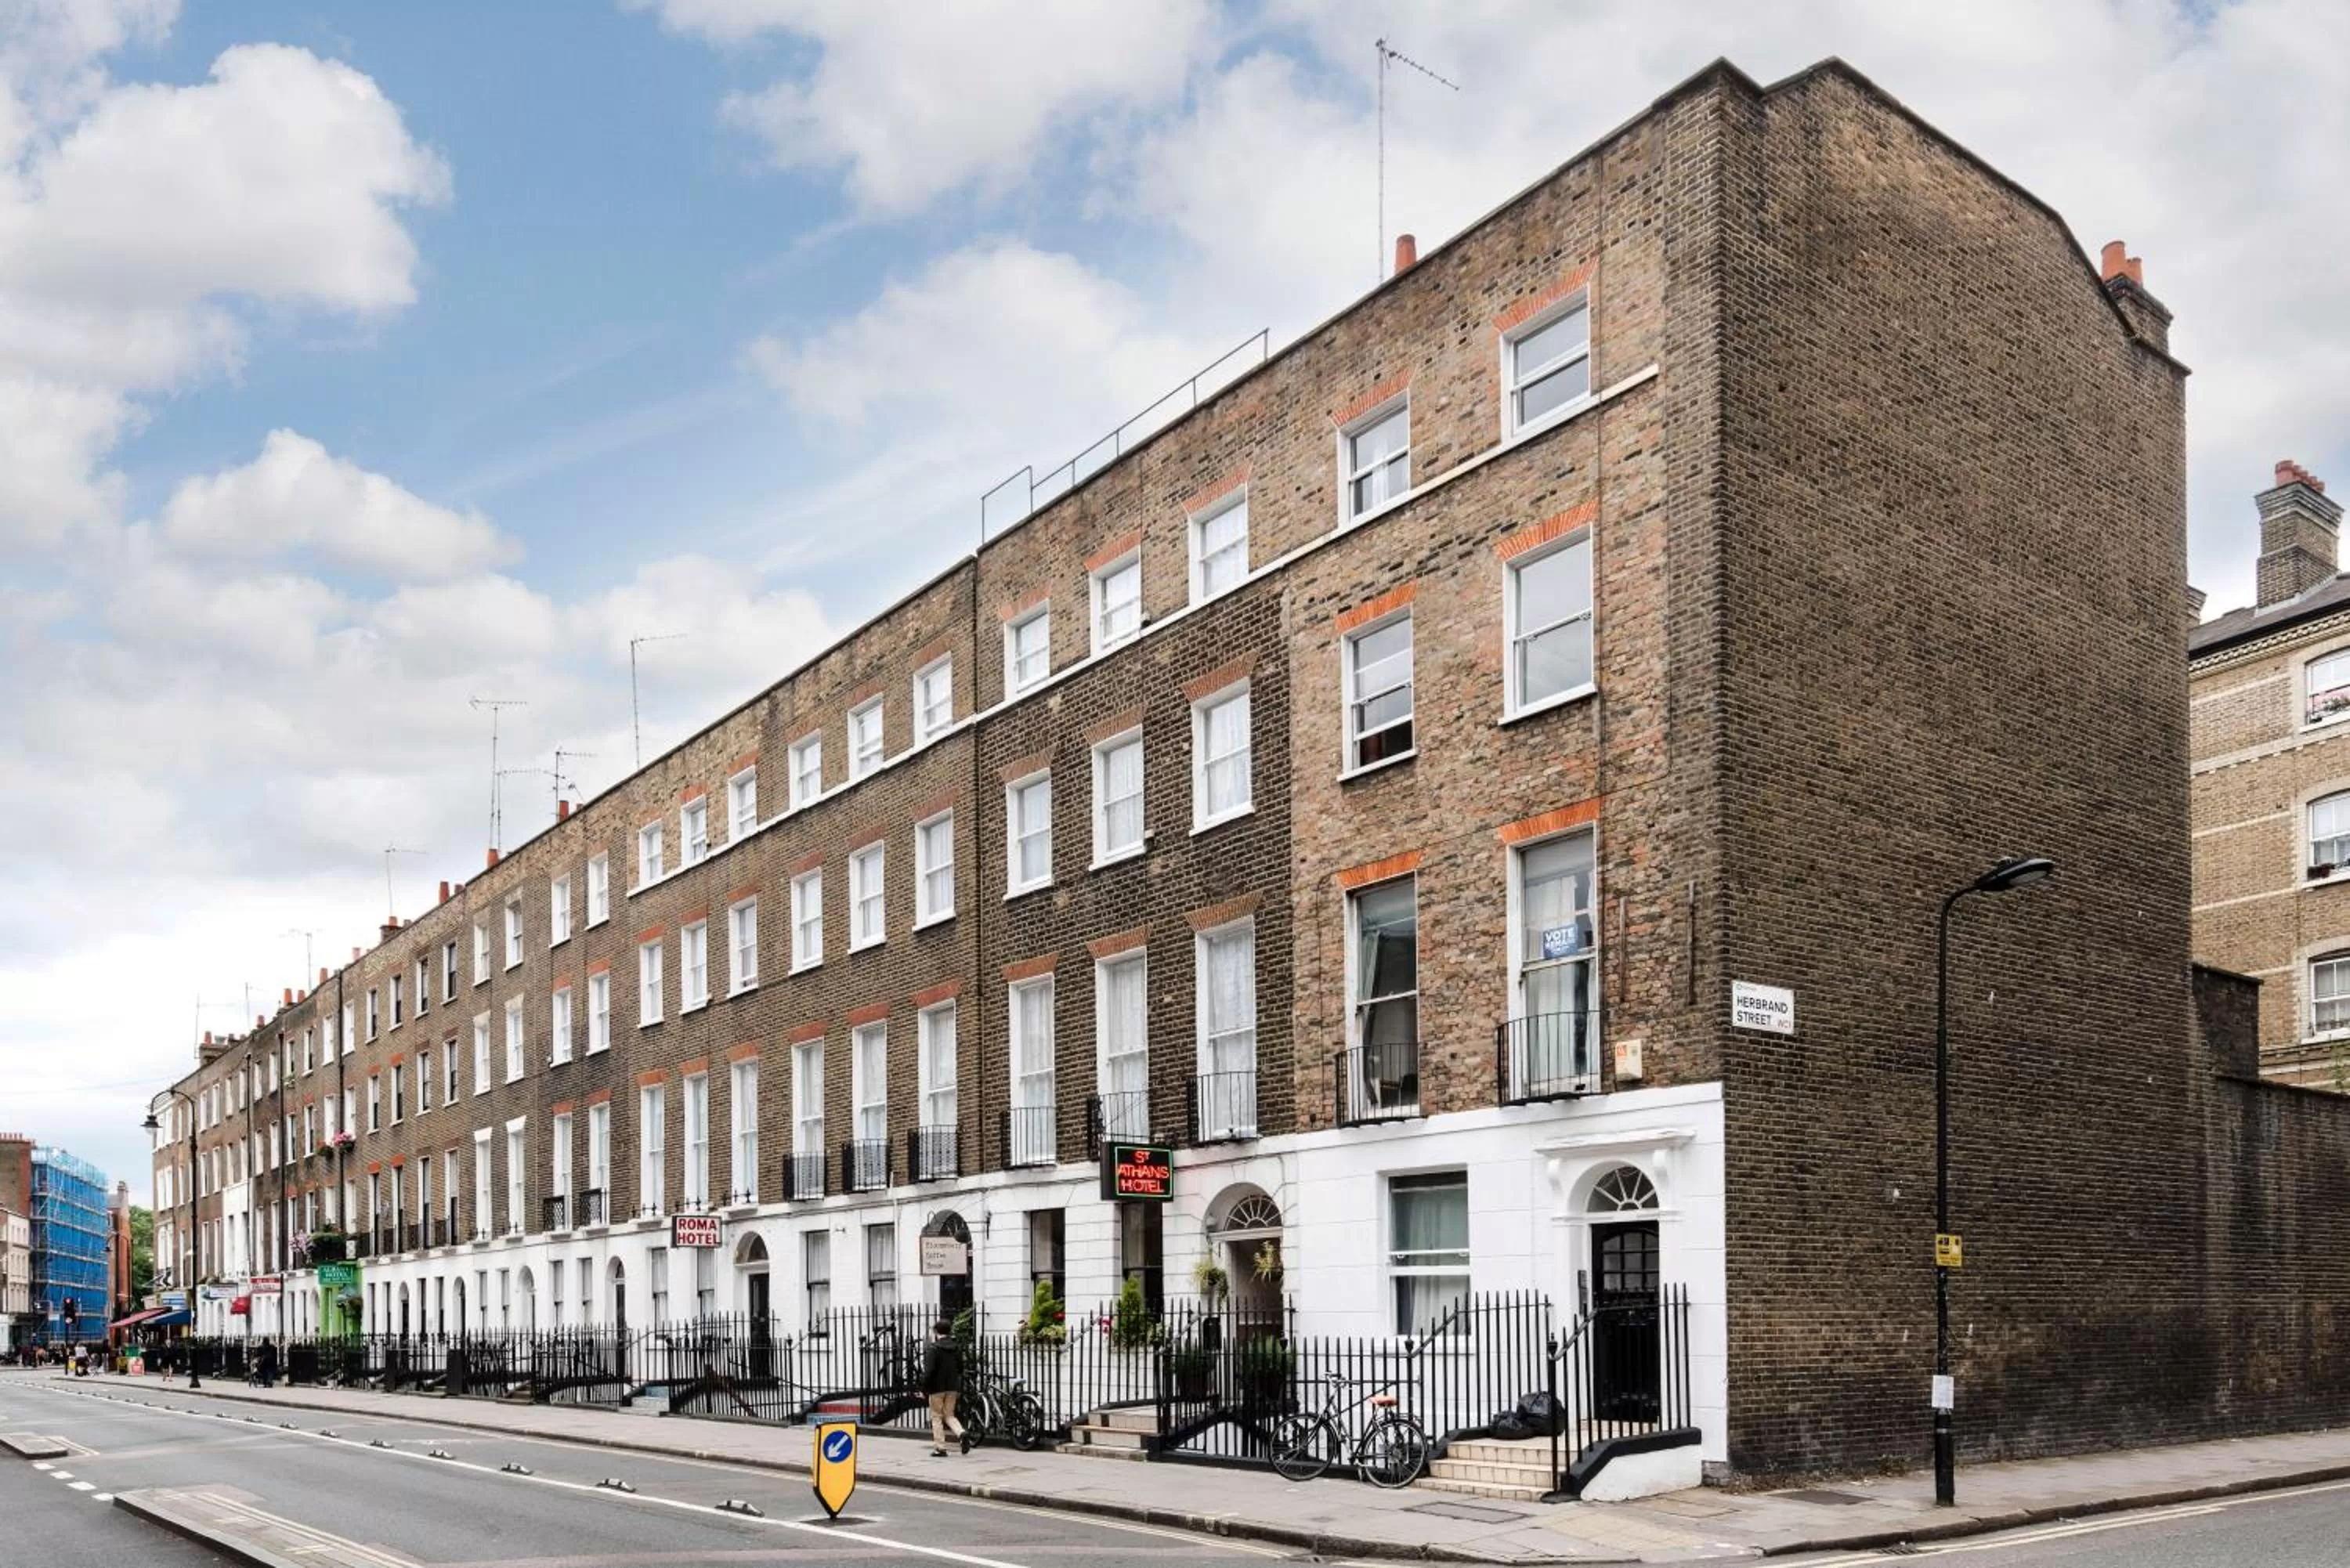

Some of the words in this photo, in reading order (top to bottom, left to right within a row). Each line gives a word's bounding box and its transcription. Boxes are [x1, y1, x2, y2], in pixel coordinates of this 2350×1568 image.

[1545, 927, 1574, 942] VOTE
[1737, 995, 1788, 1014] HERBRAND
[1737, 1010, 1771, 1025] STREET
[1118, 1163, 1169, 1179] ATHANS
[1120, 1179, 1165, 1193] HOTEL
[678, 1218, 718, 1231] ROMA
[677, 1232, 721, 1245] HOTEL
